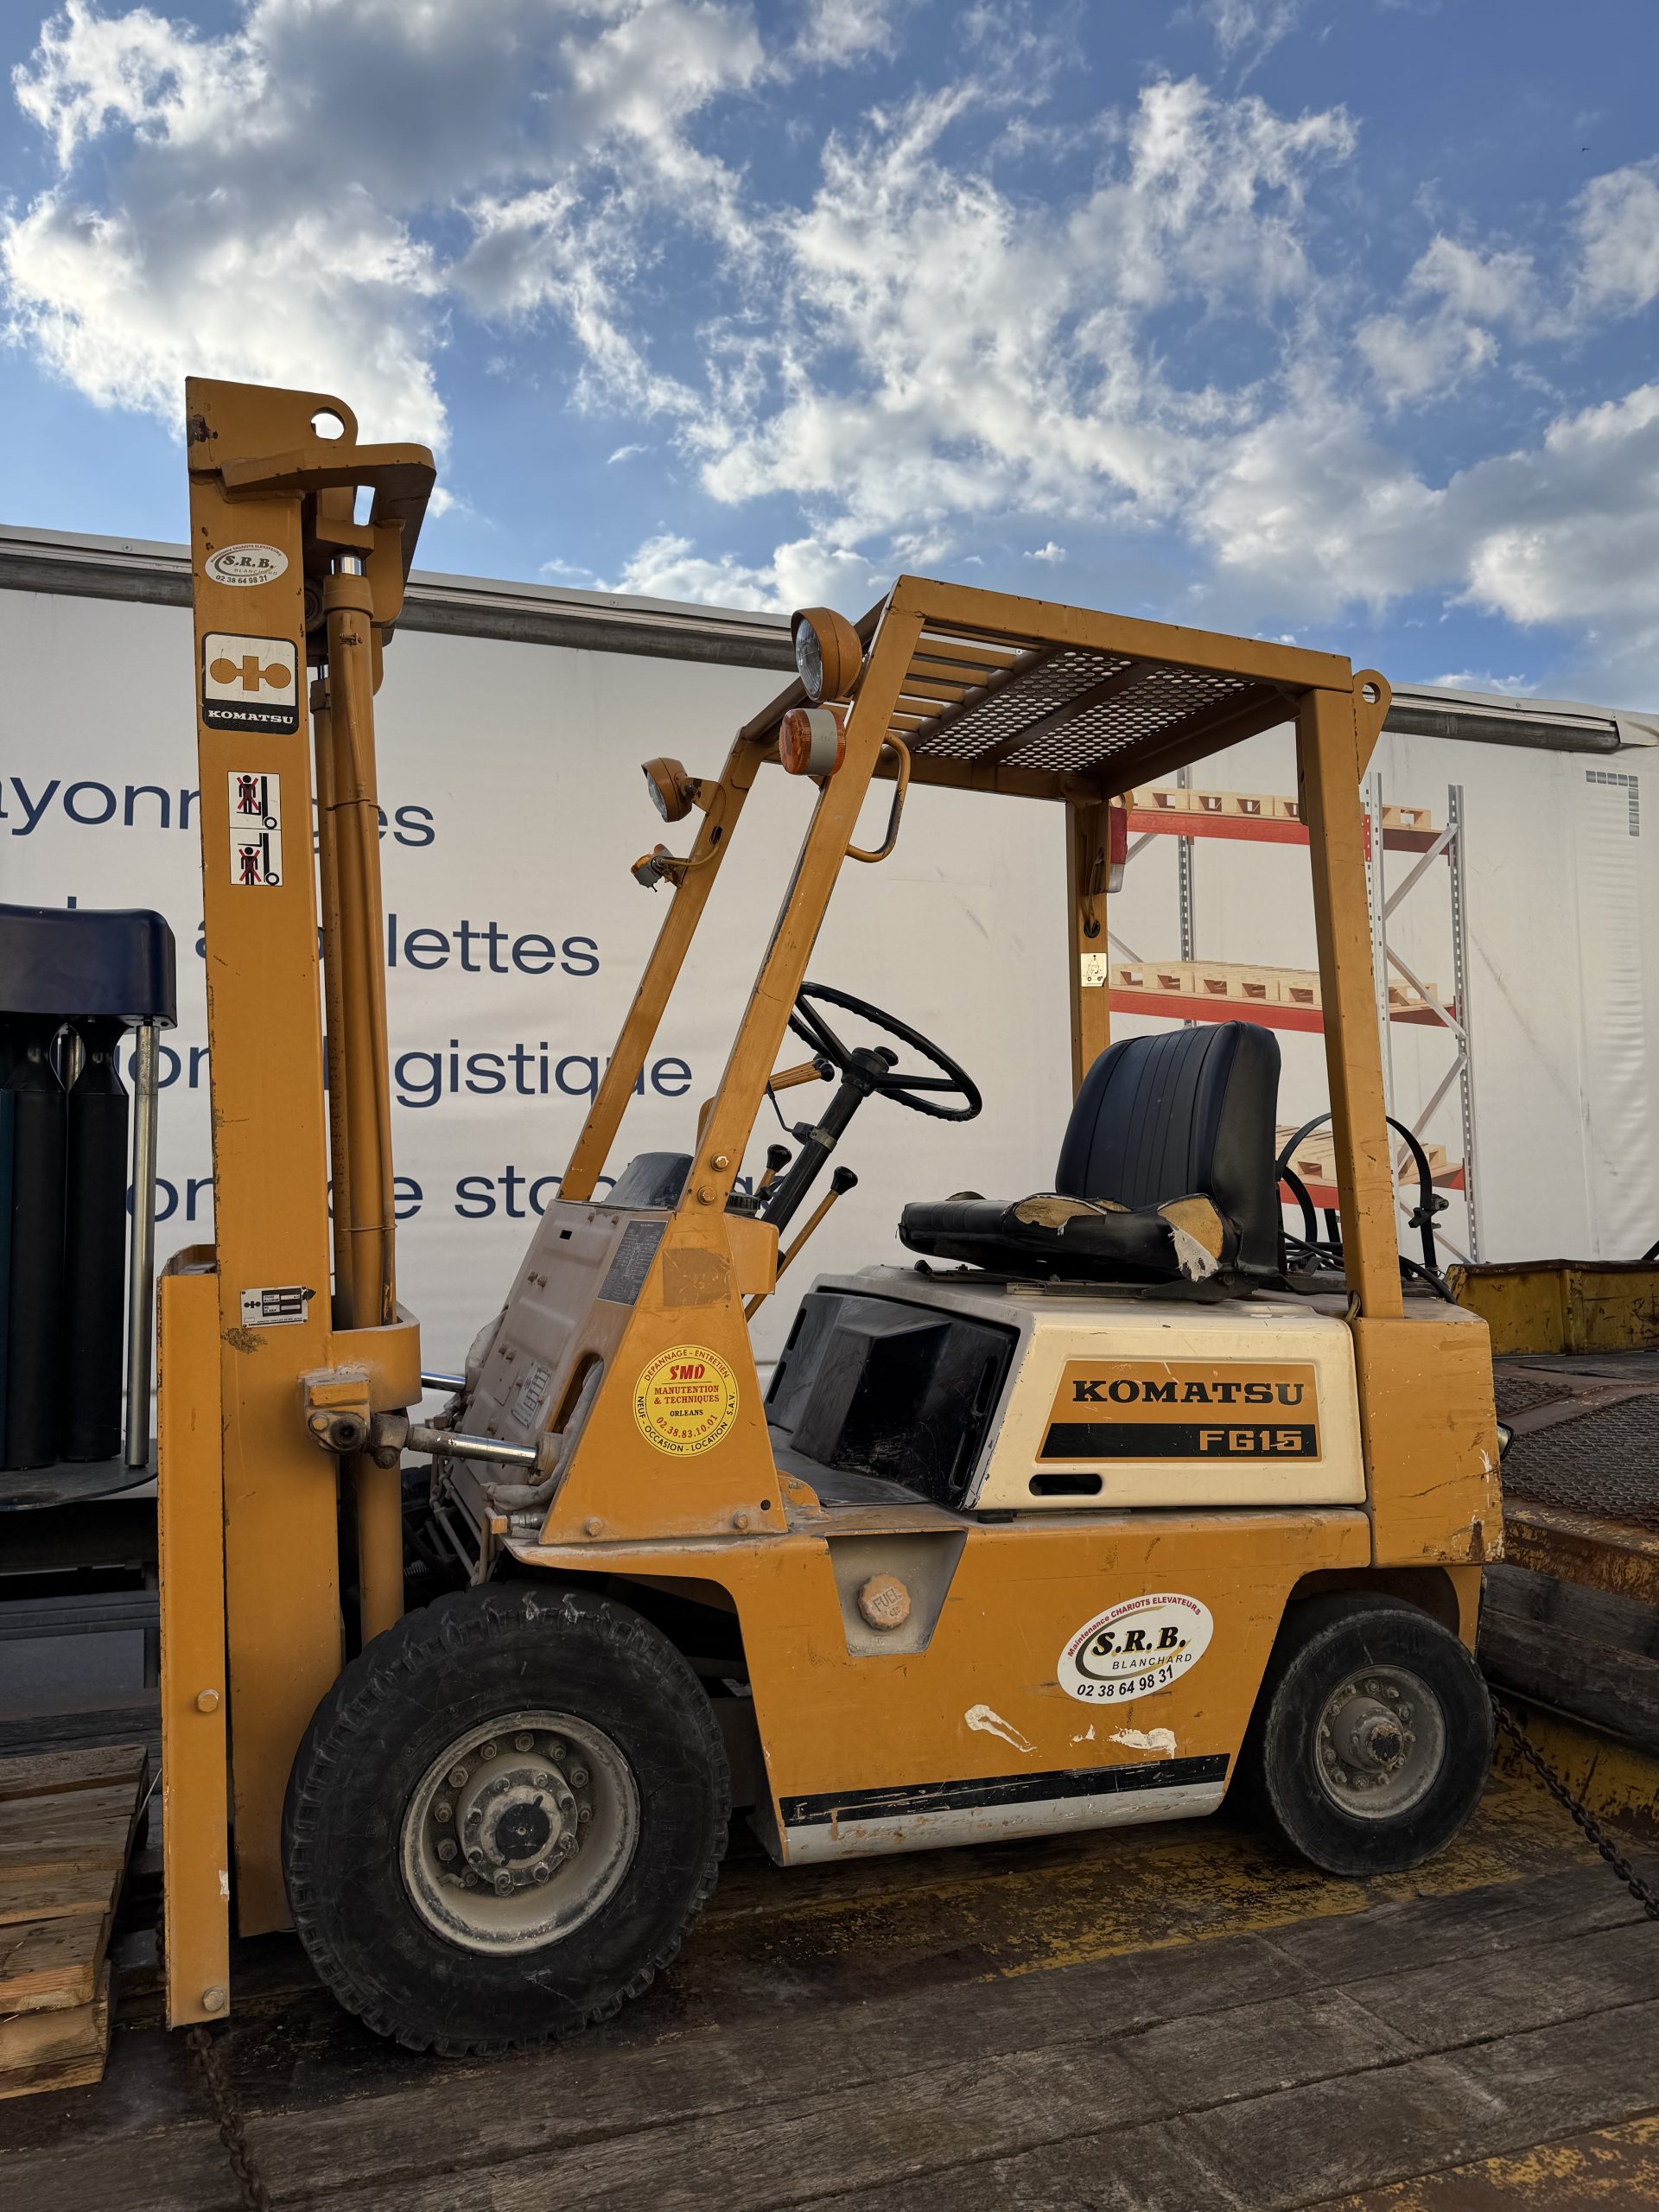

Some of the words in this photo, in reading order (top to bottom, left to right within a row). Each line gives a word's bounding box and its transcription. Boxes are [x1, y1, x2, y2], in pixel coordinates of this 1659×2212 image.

[207, 709, 294, 724] KOMATSU
[644, 1350, 688, 1382] DEPANNAGE
[695, 1350, 730, 1378] ENTRETIEN
[670, 1363, 706, 1380] SMD
[654, 1385, 719, 1395] MANUTENTION
[664, 1395, 720, 1404] TECHNIQUES
[1072, 1379, 1304, 1405] KOMATSU
[638, 1395, 646, 1419] NEUF
[645, 1425, 683, 1452] OCCASION
[691, 1422, 728, 1452] LOCATION
[656, 1414, 718, 1439] 02.38.83.10.01
[1199, 1431, 1302, 1451] FG15
[1068, 1616, 1110, 1657] Maintenance
[1111, 1599, 1151, 1618] CHARIOTS
[1153, 1597, 1201, 1616] ELEVATEURS
[1112, 1653, 1192, 1669] BLANCHARD
[1077, 1684, 1094, 1696] 02
[1098, 1684, 1115, 1697] 38
[1119, 1681, 1135, 1695] 64
[1139, 1674, 1155, 1691] 98
[1159, 1664, 1173, 1683] 31
